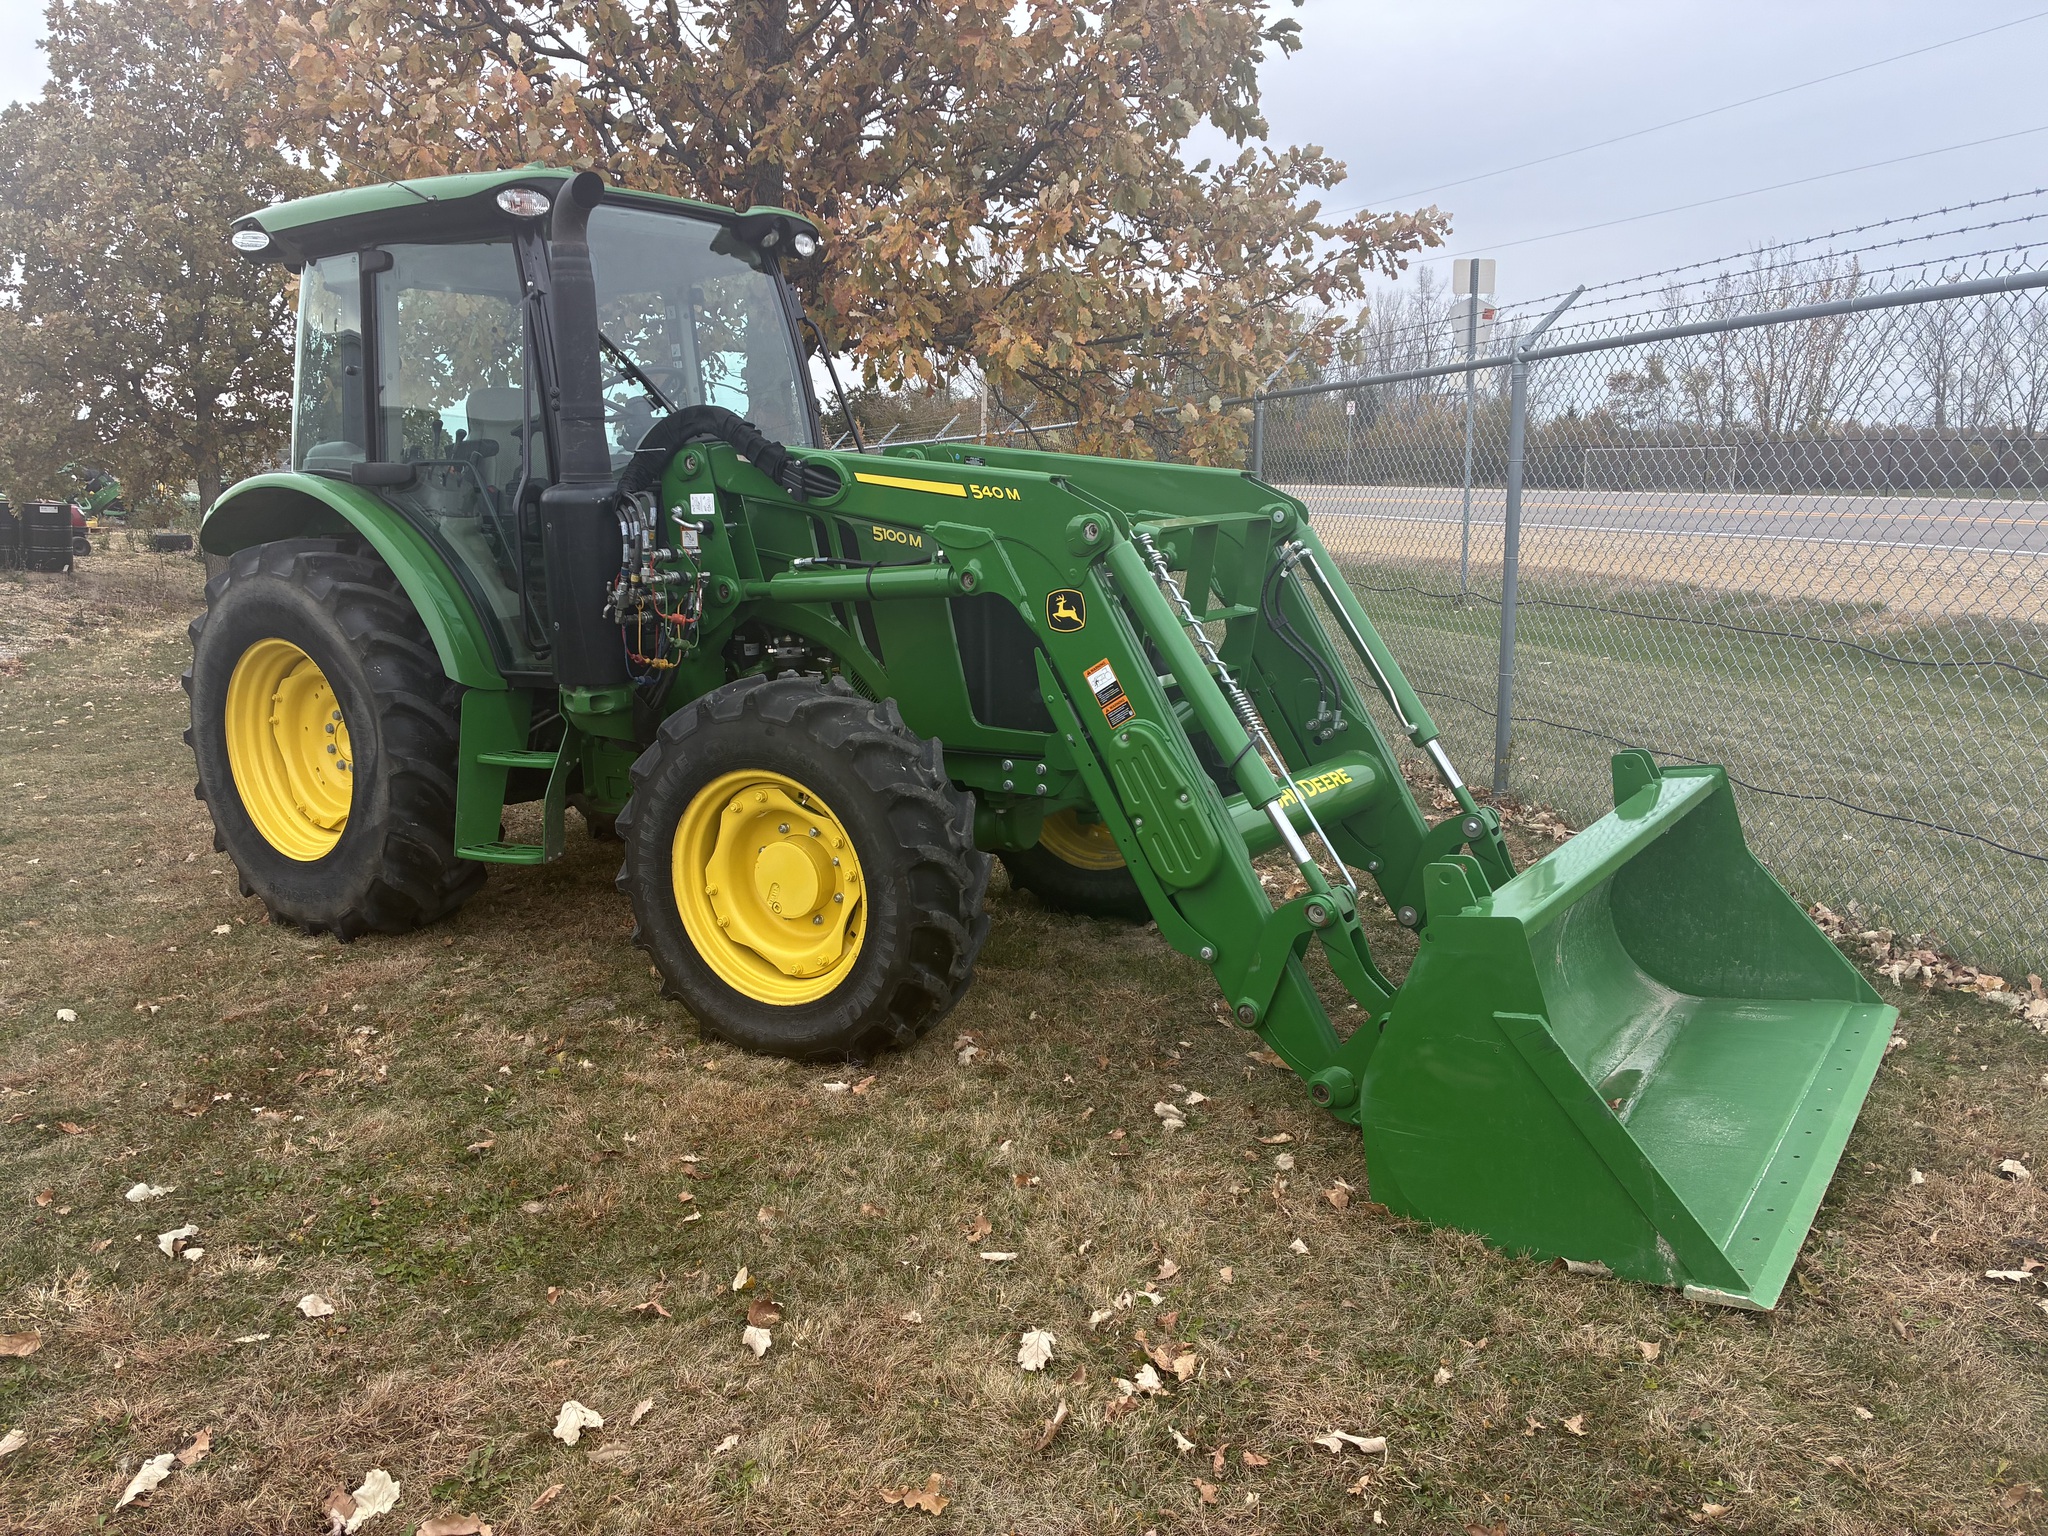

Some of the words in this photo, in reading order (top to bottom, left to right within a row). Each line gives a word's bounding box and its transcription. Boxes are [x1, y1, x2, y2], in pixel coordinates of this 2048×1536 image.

[969, 484, 1003, 500] 540
[1004, 487, 1021, 501] M
[872, 526, 907, 544] 5100
[909, 533, 923, 549] M
[1296, 767, 1353, 797] DEERE
[834, 891, 898, 1030] ALLIANCE
